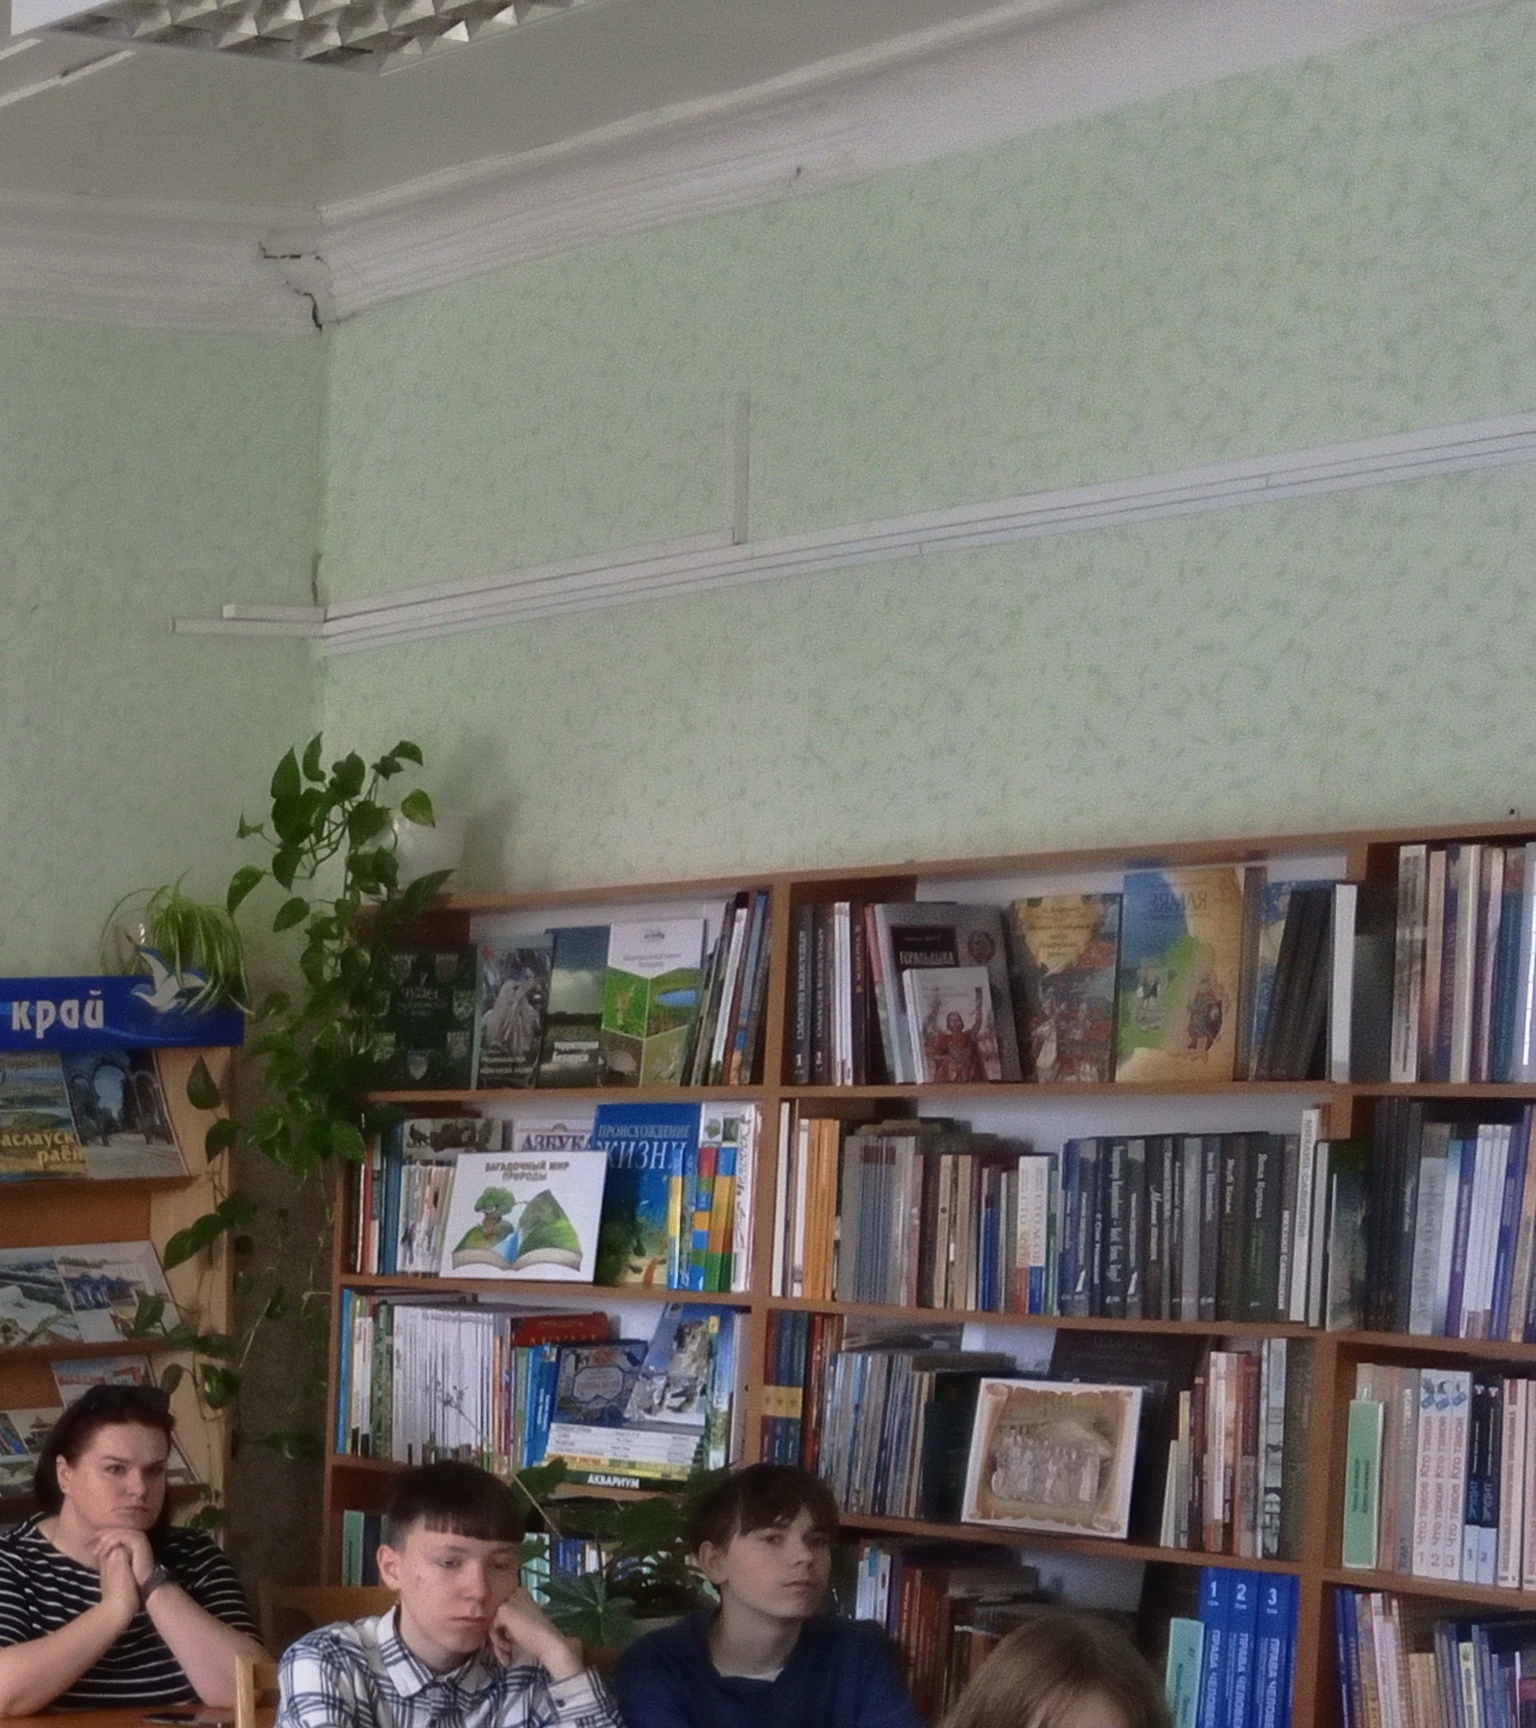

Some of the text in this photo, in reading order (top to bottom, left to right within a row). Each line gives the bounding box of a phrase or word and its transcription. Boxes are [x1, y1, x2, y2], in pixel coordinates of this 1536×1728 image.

[11, 989, 105, 1039] край
[587, 1473, 640, 1490] АКВАРИУМ
[1210, 1580, 1217, 1597] 1
[1236, 1583, 1247, 1601] 2
[1267, 1588, 1278, 1606] 3
[1209, 1629, 1221, 1669] ПРАВА
[1237, 1632, 1249, 1673] ПРАВА
[1267, 1638, 1280, 1679] ПРАВА
